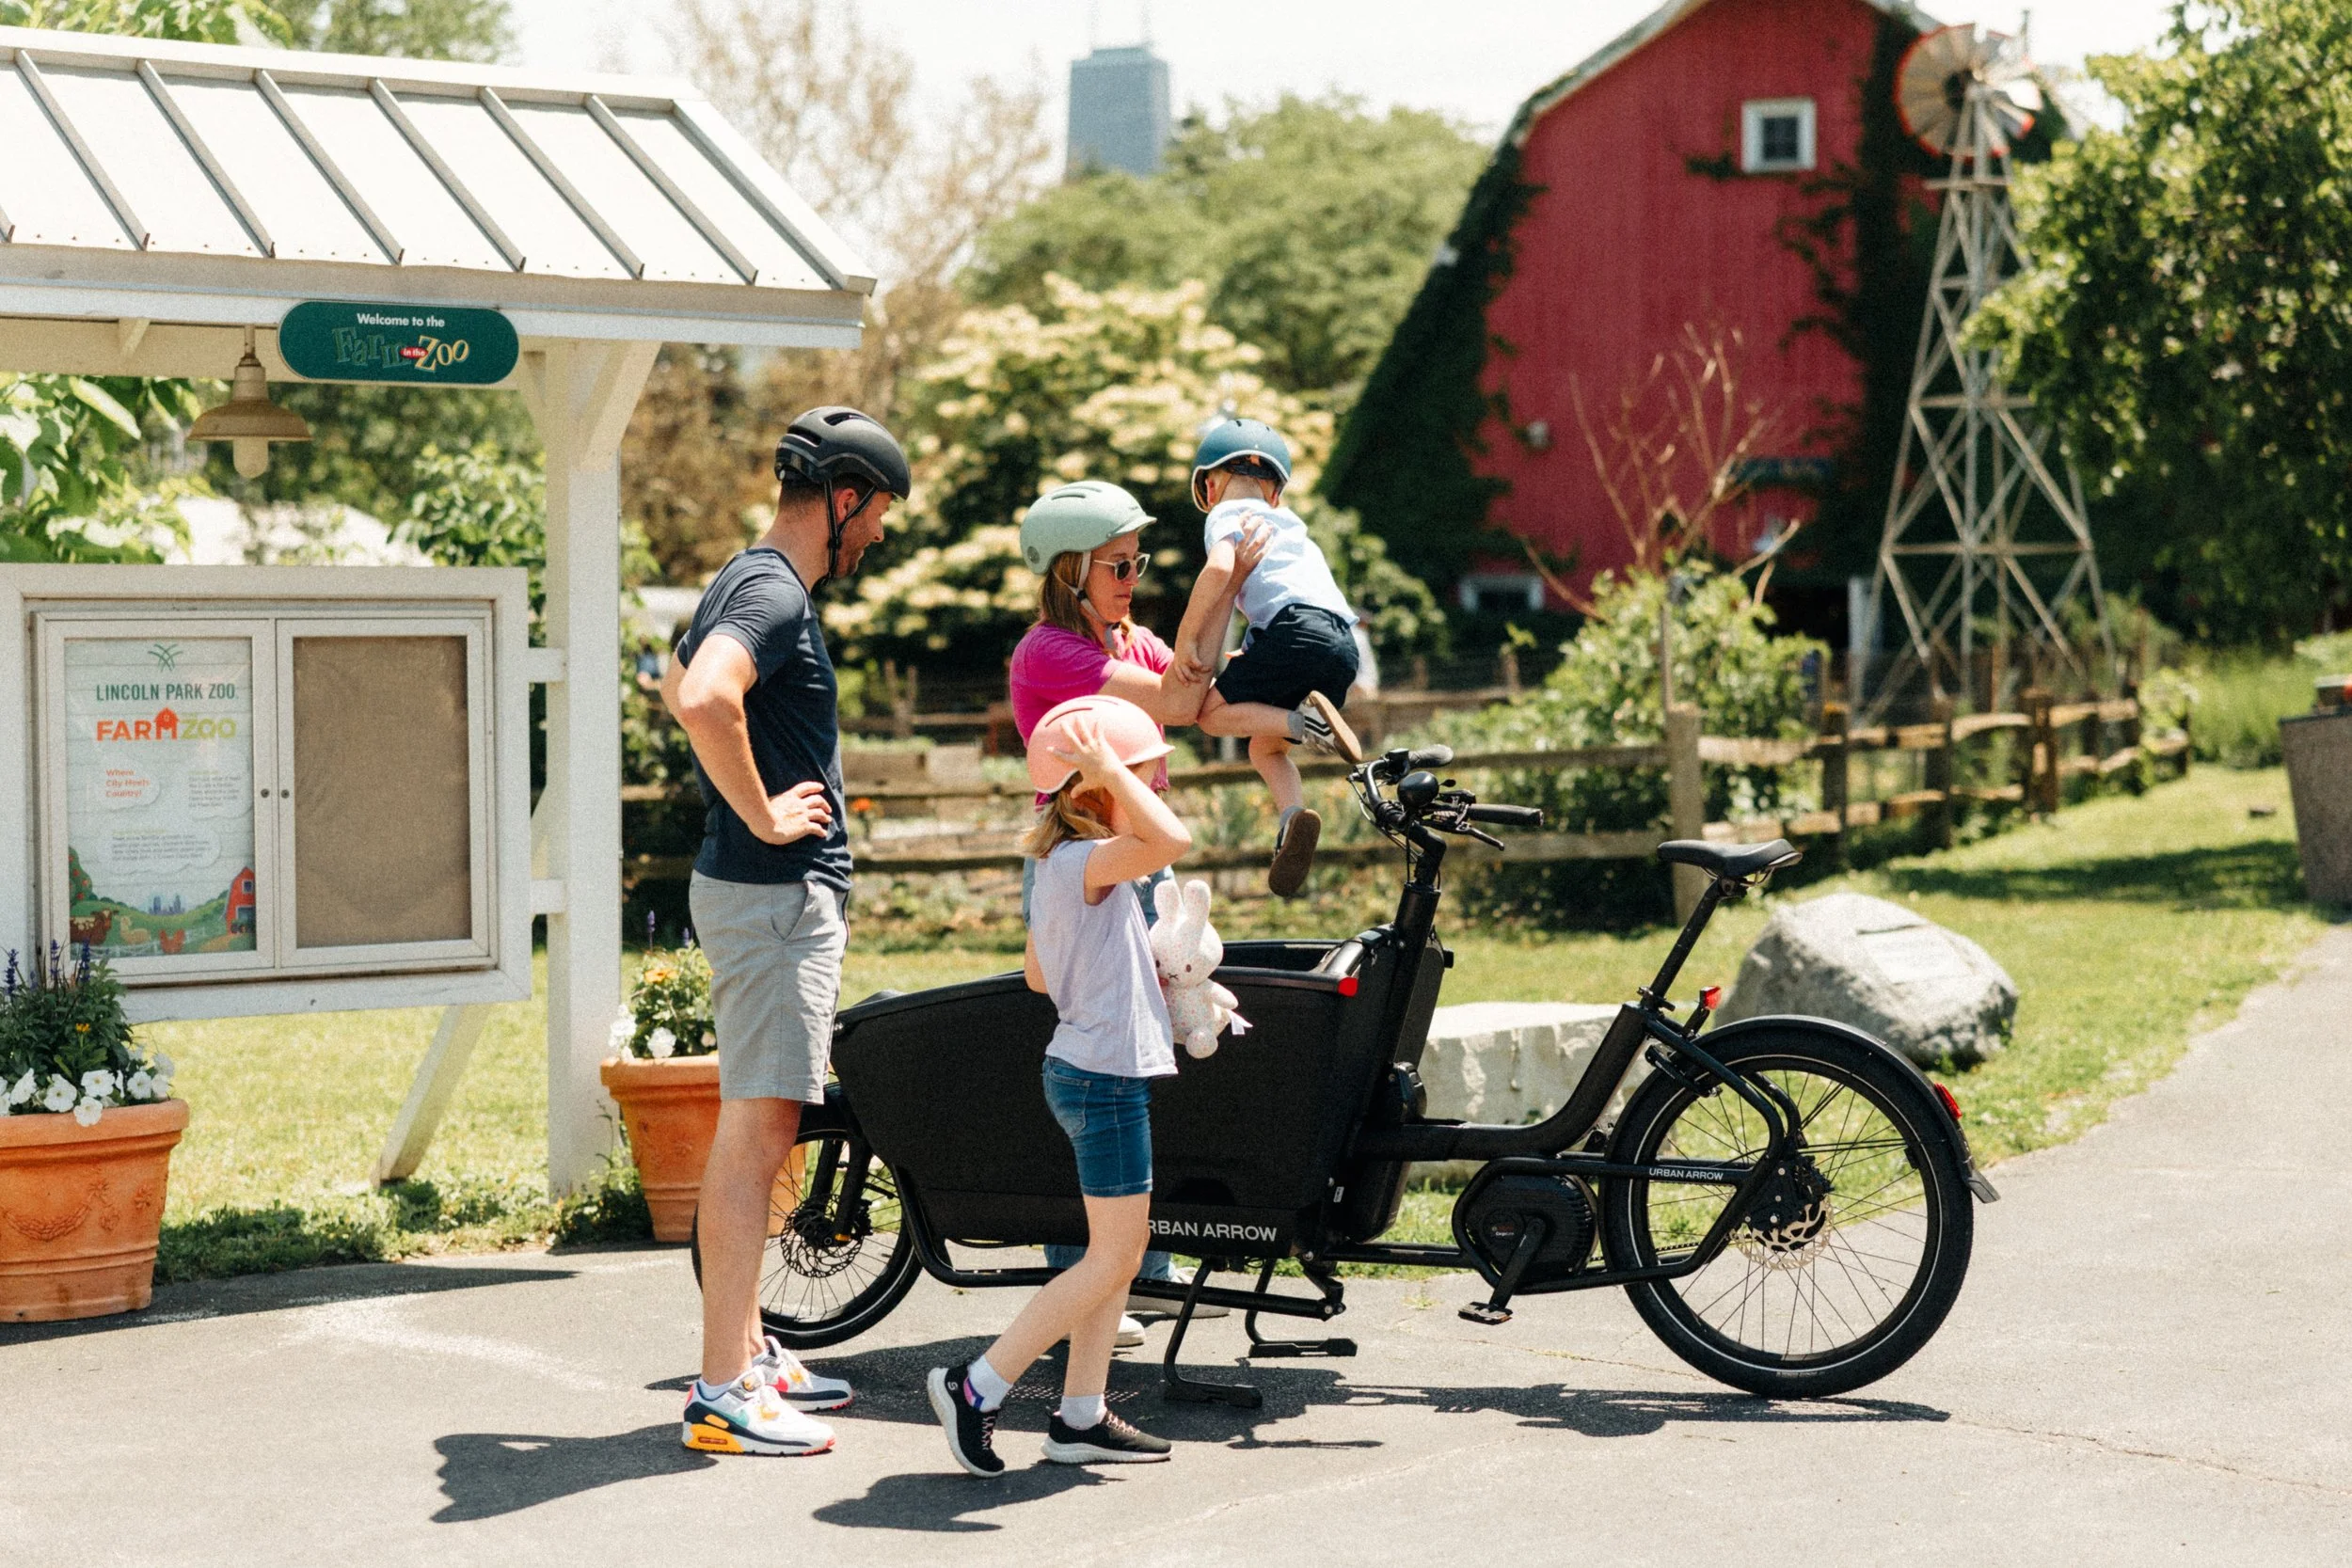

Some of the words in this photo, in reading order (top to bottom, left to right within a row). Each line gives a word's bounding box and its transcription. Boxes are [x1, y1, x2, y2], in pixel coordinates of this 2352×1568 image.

[357, 313, 409, 326] Welcome
[412, 316, 424, 326] to
[426, 316, 445, 327] the
[331, 326, 411, 368] Farm
[403, 348, 412, 356] in
[412, 348, 426, 356] the
[415, 335, 469, 372] Zoo
[96, 684, 160, 702] LINCOLN
[166, 684, 203, 701] PARK
[208, 683, 236, 700] ZOO
[1649, 1167, 1684, 1179] URBAN
[1685, 1171, 1724, 1181] ARROW
[1149, 1219, 1199, 1236] RBAN
[1202, 1223, 1278, 1242] ARROW
